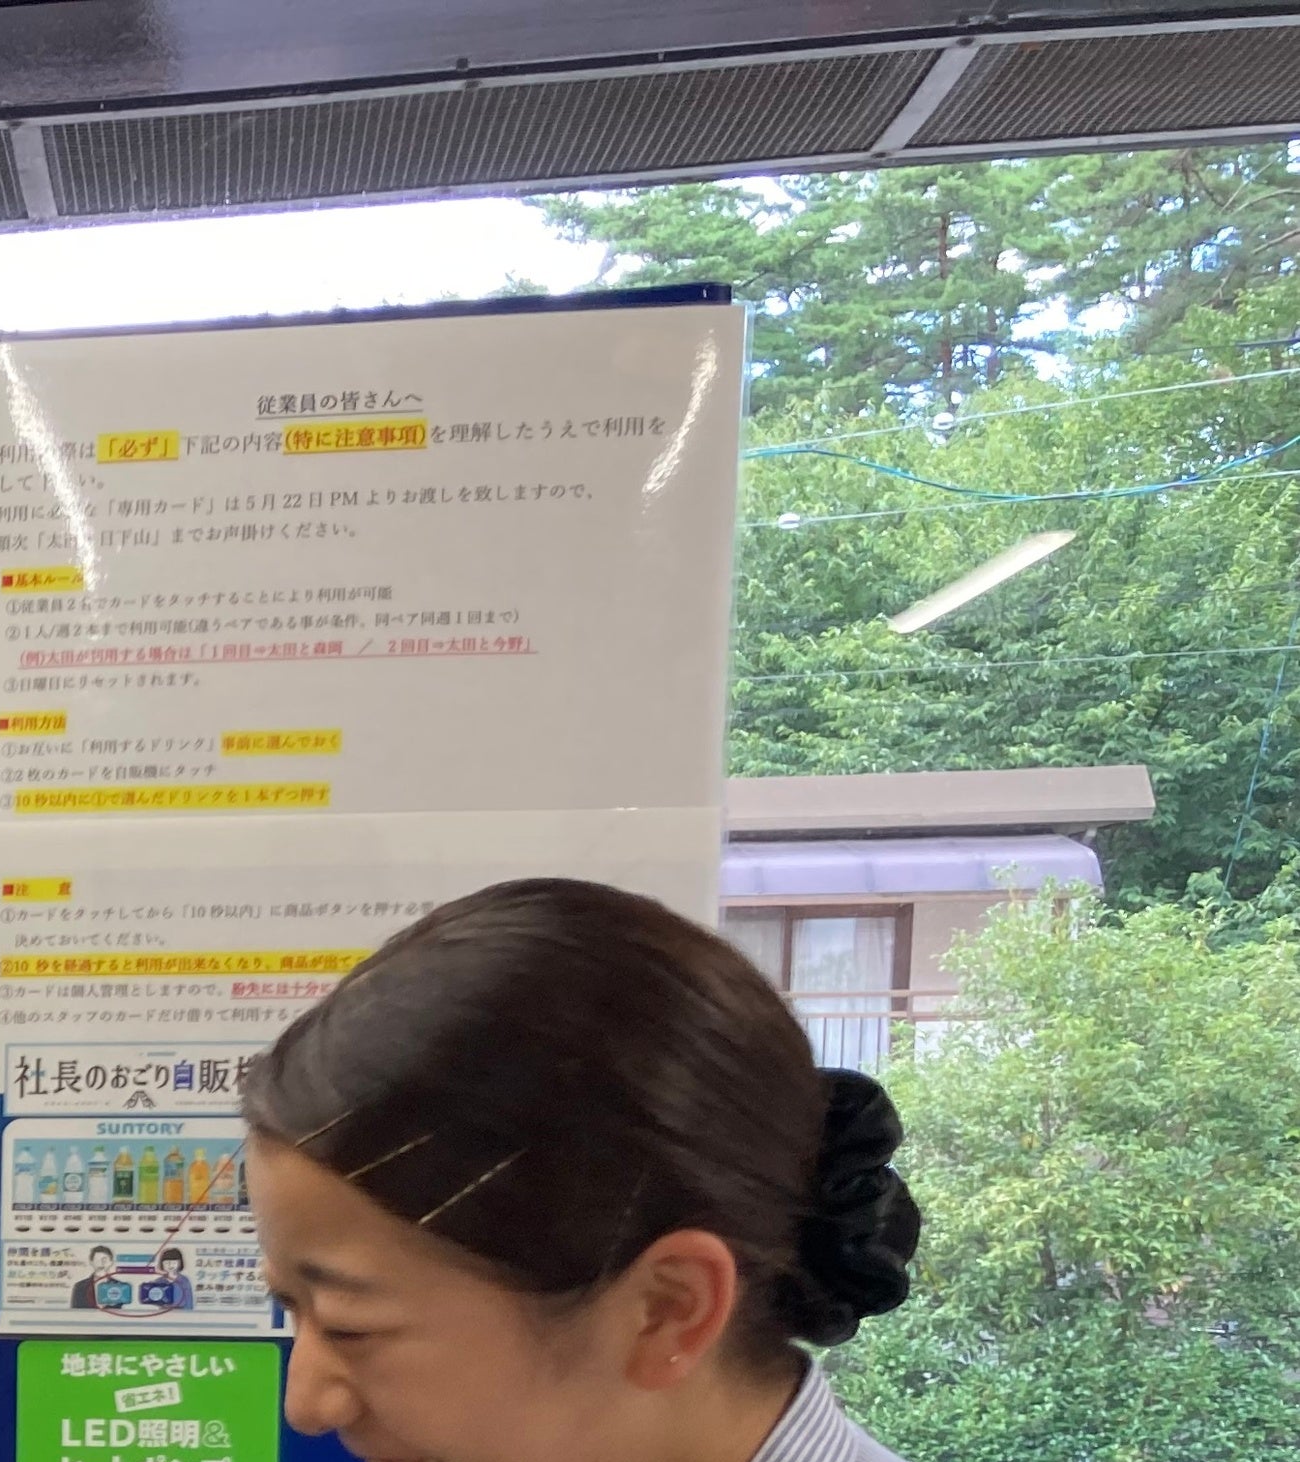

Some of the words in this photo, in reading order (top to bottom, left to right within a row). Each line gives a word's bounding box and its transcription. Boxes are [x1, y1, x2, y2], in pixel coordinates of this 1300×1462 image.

[257, 390, 423, 417] 従業員の皆さんへ
[96, 1122, 186, 1136] SUNTORY
[61, 1353, 234, 1378] 地球にやさしい
[120, 1384, 177, 1409] 省エネ!
